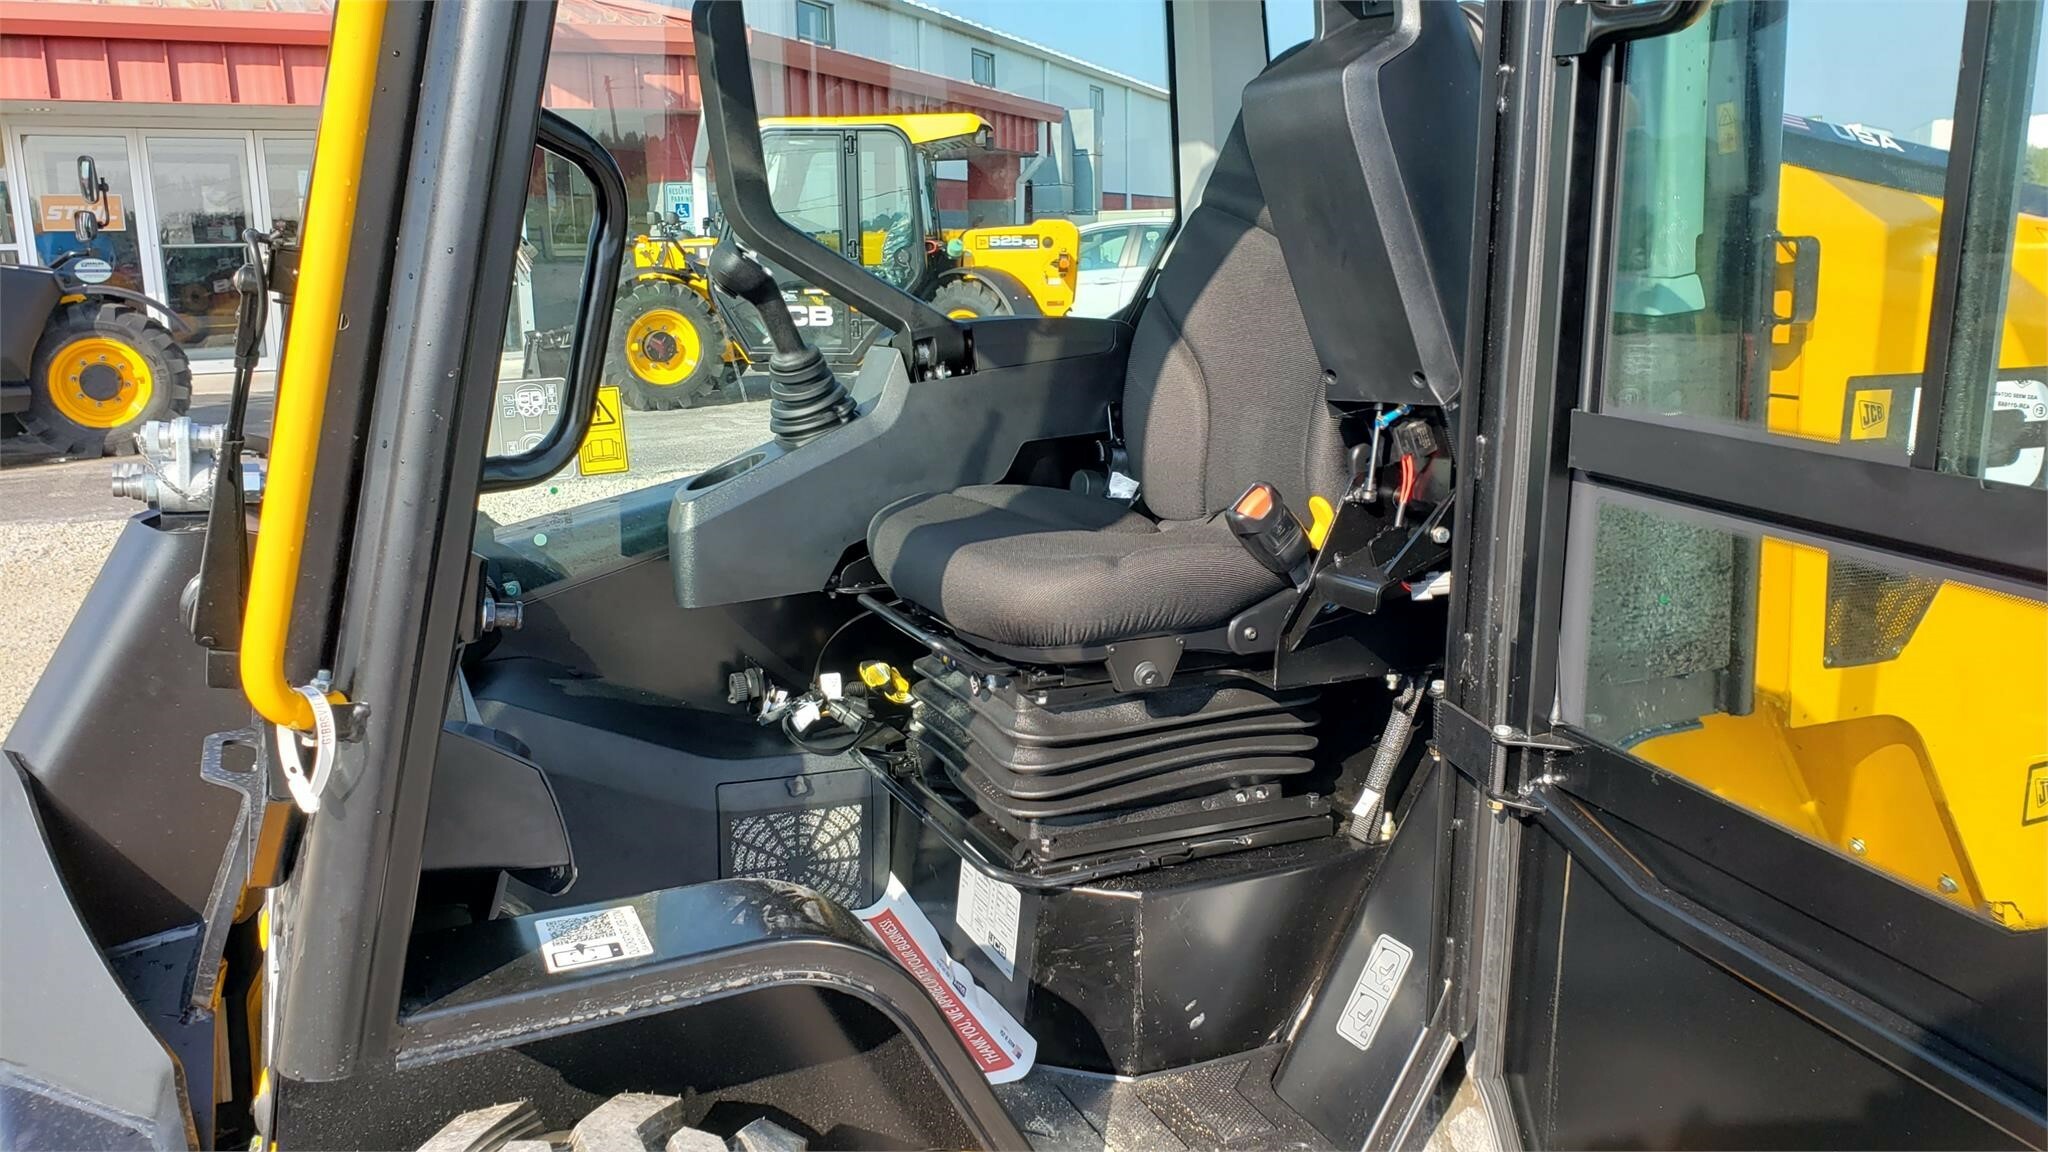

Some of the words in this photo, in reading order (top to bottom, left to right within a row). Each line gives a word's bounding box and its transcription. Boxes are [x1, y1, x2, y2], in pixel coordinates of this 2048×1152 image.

[1828, 123, 1904, 152] USA
[787, 305, 834, 327] CB
[1861, 402, 1883, 427] JCB
[878, 918, 911, 951] BUSINESS!
[901, 949, 925, 970] YOUR
[917, 967, 957, 1009] APPRECIATE
[946, 1007, 965, 1023] WE
[957, 1018, 980, 1039] YOU,
[969, 1036, 1001, 1064] THANK
